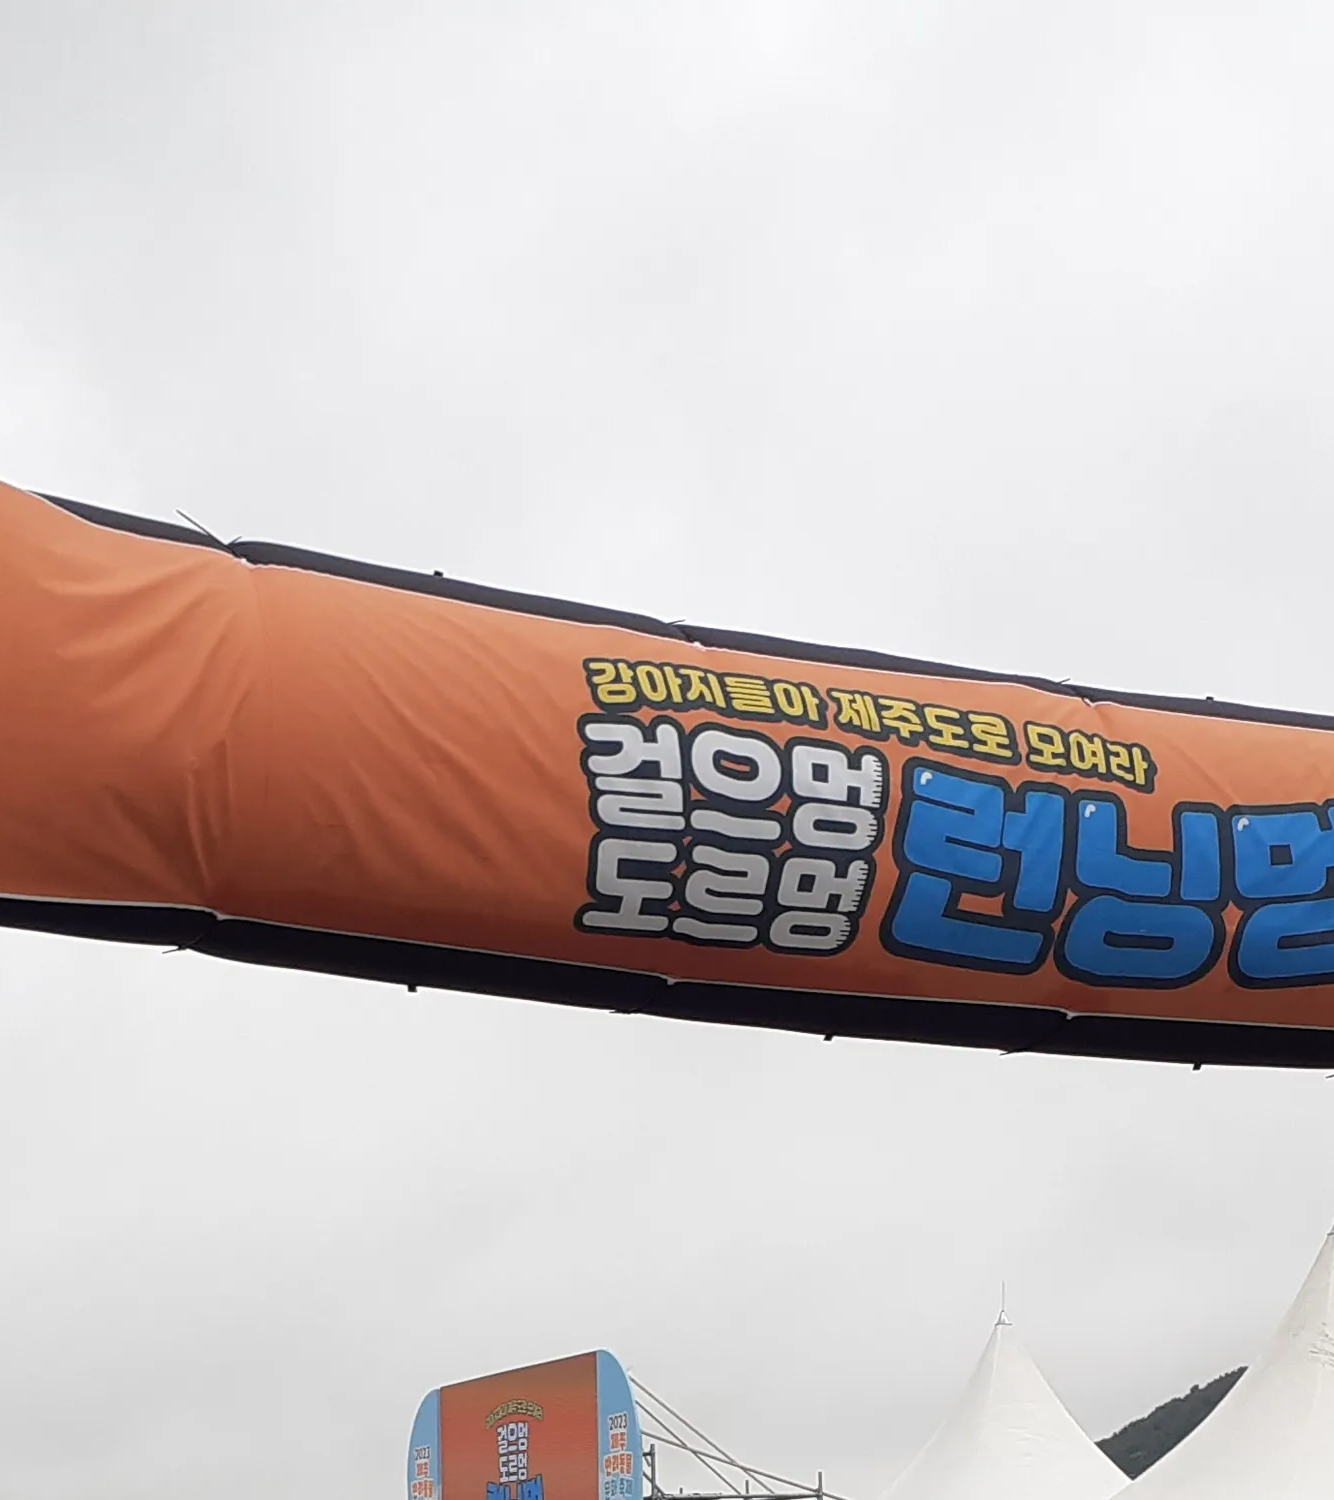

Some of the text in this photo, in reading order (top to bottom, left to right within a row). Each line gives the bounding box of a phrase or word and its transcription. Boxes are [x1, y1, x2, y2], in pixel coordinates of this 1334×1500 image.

[588, 661, 1150, 786] 강아지들아 제주도로 모여라
[584, 722, 883, 851] 걸으멍
[581, 838, 869, 950] 도르멍
[496, 1421, 529, 1454] 걸으멍
